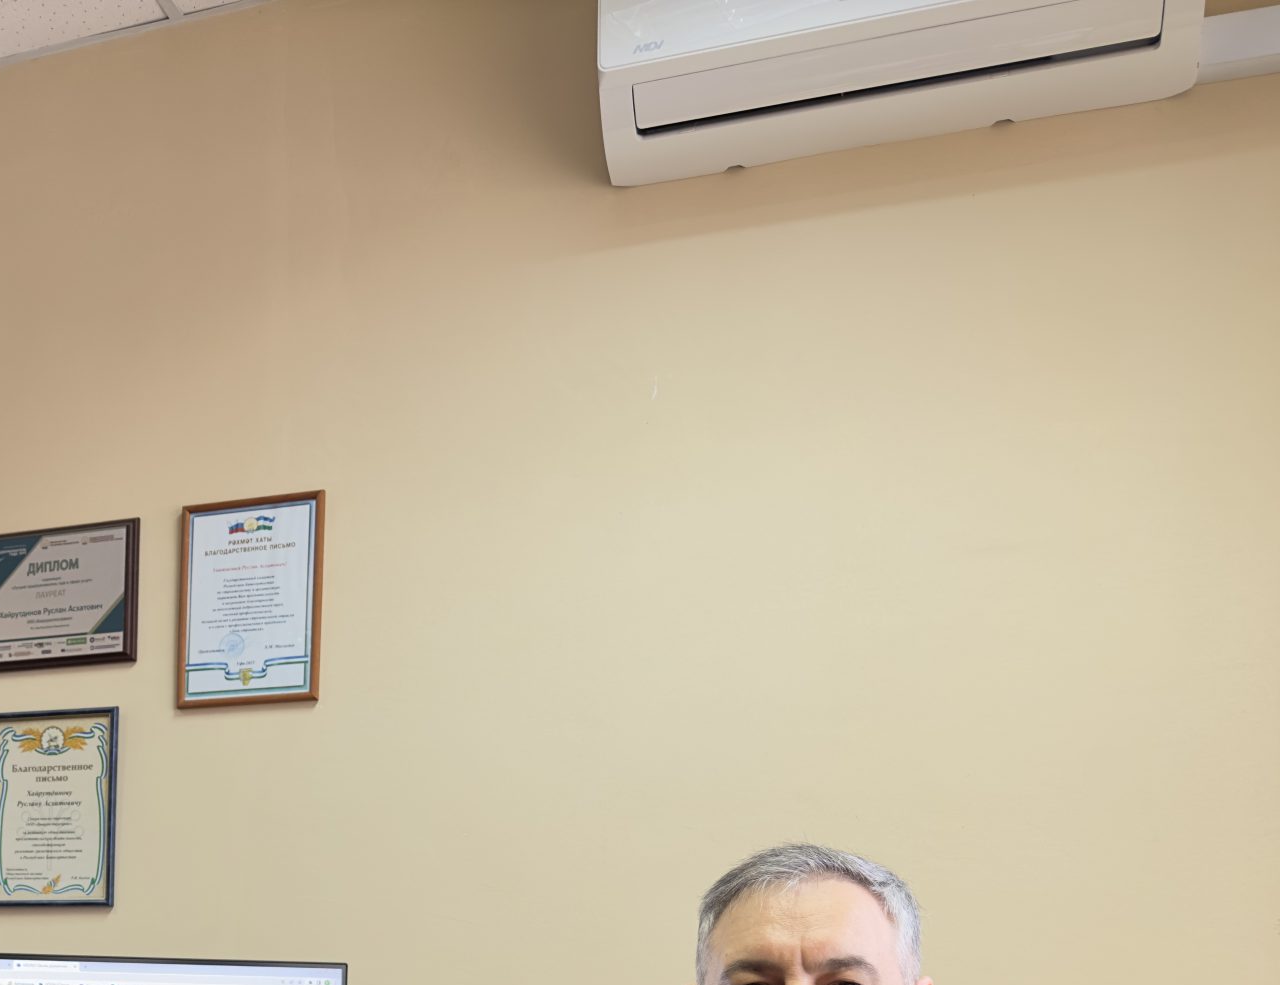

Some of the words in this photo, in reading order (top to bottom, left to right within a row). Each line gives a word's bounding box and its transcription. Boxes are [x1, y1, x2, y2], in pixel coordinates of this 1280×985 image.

[204, 545, 268, 557] БЛАГОДАРСТВЕННОЕ
[269, 541, 296, 550] ПИСЬМО
[26, 557, 80, 576] ДИПЛОМ
[12, 763, 94, 774] Благодарственное
[35, 775, 68, 783] письмо
